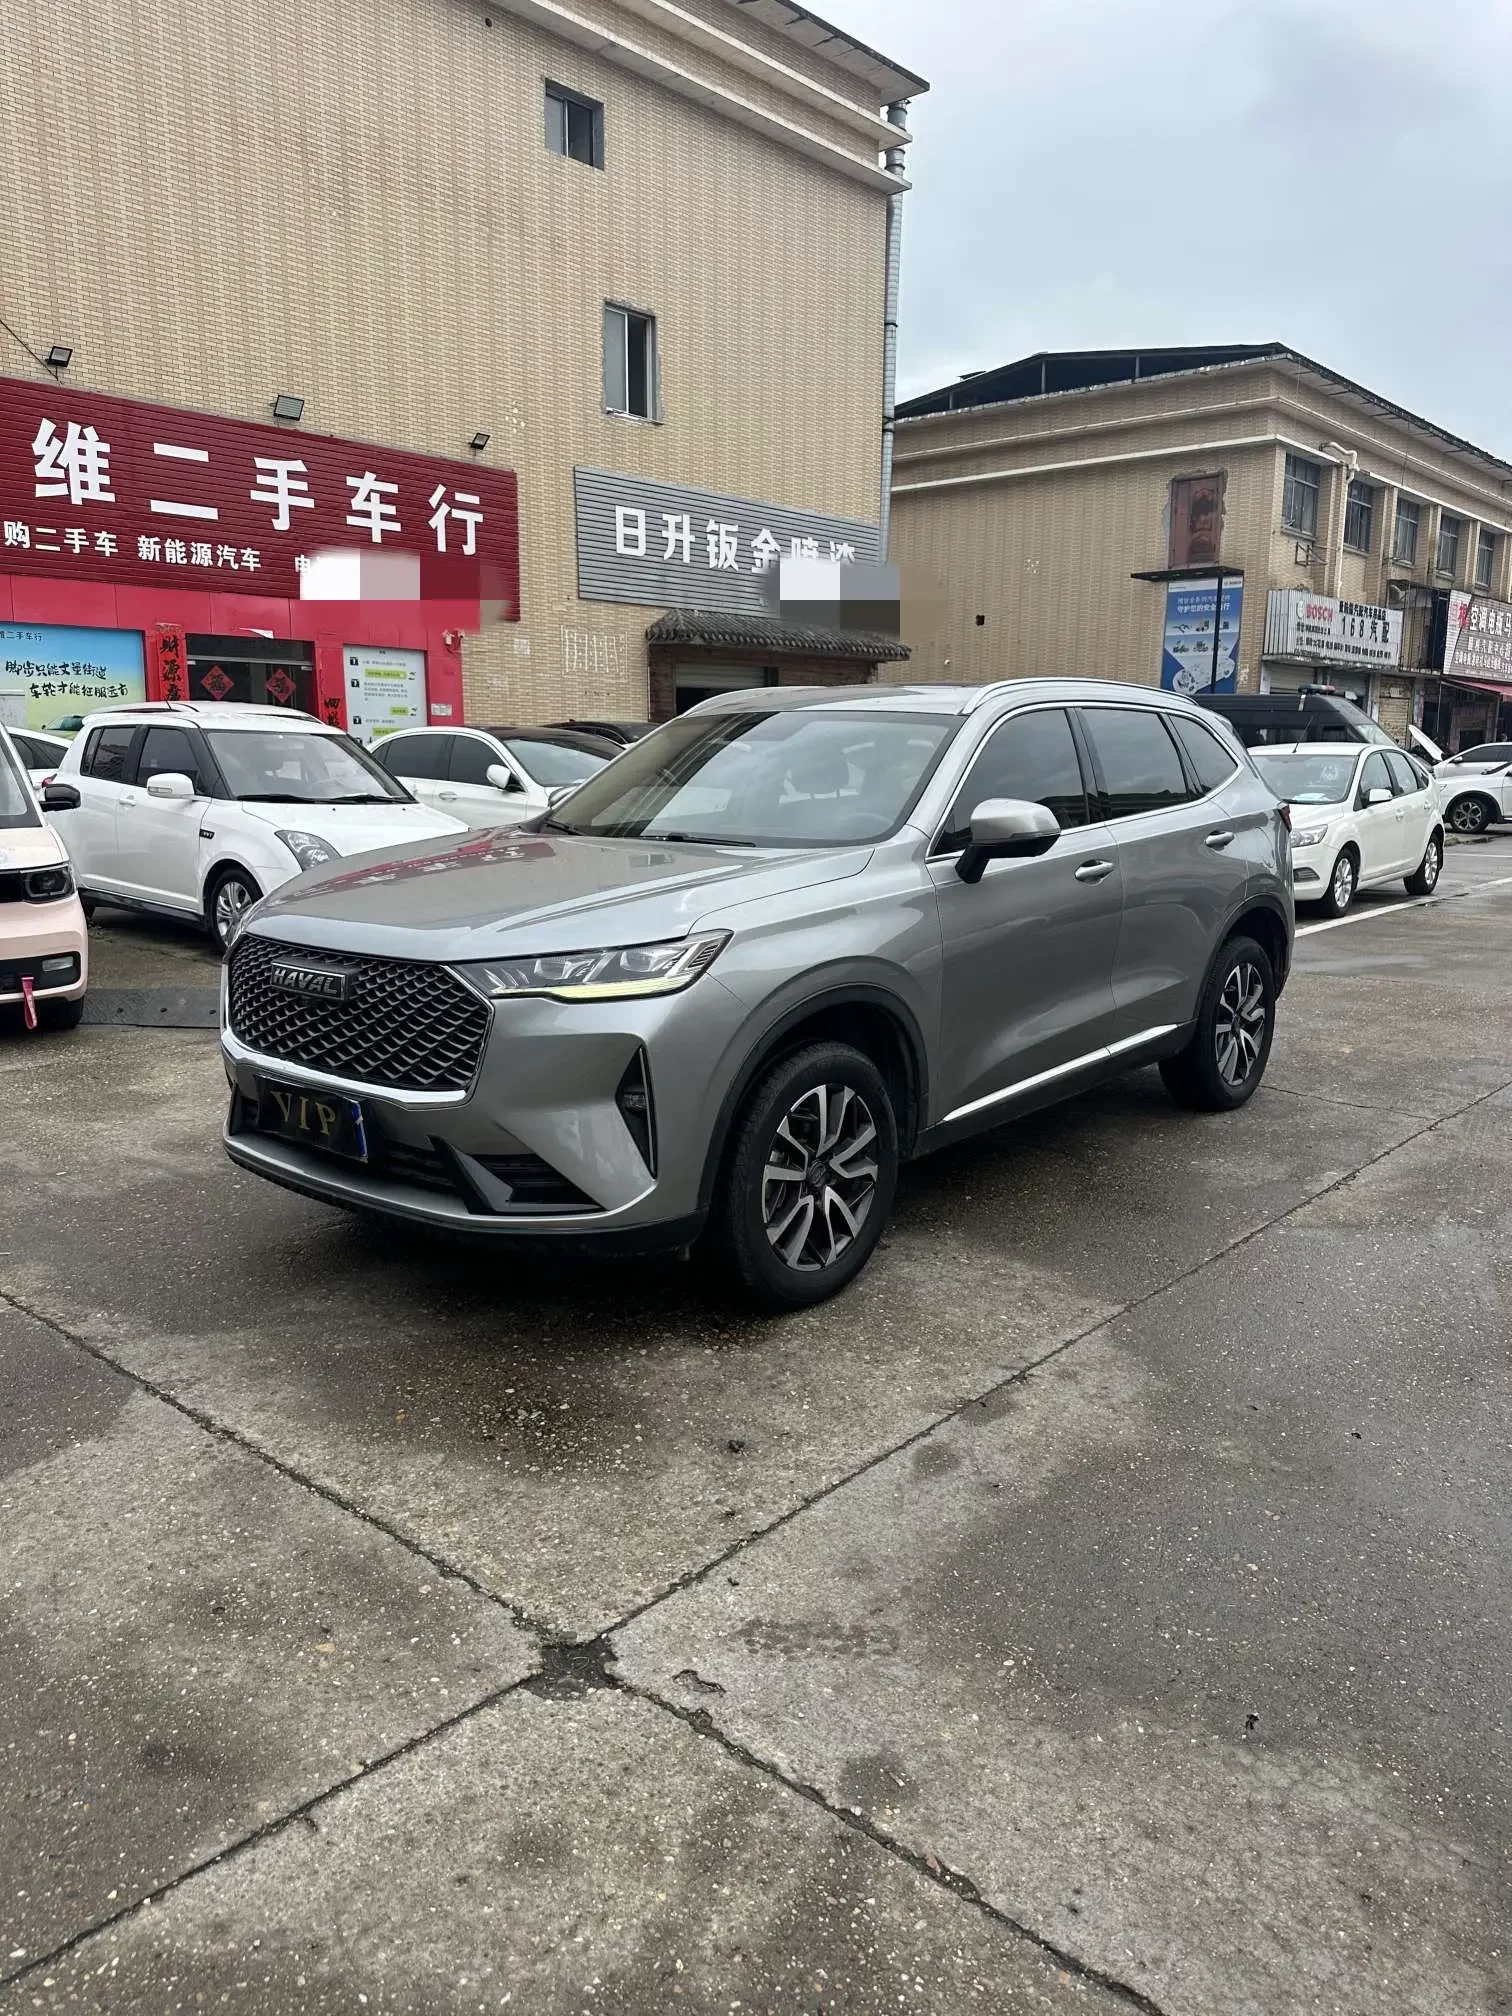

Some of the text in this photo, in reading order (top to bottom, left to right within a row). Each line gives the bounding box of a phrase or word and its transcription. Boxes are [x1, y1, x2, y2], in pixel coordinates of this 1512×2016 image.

[32, 417, 485, 556] 维二手车行
[3, 520, 119, 557] 购二手车
[137, 535, 262, 572] 新能源汽车
[1305, 603, 1334, 623] BOSCH
[5, 660, 107, 680] 脚步只能丈量街道
[29, 681, 129, 699] 车轮才能征服远方
[273, 967, 338, 995] HAVAL
[270, 1090, 336, 1136] VIP
